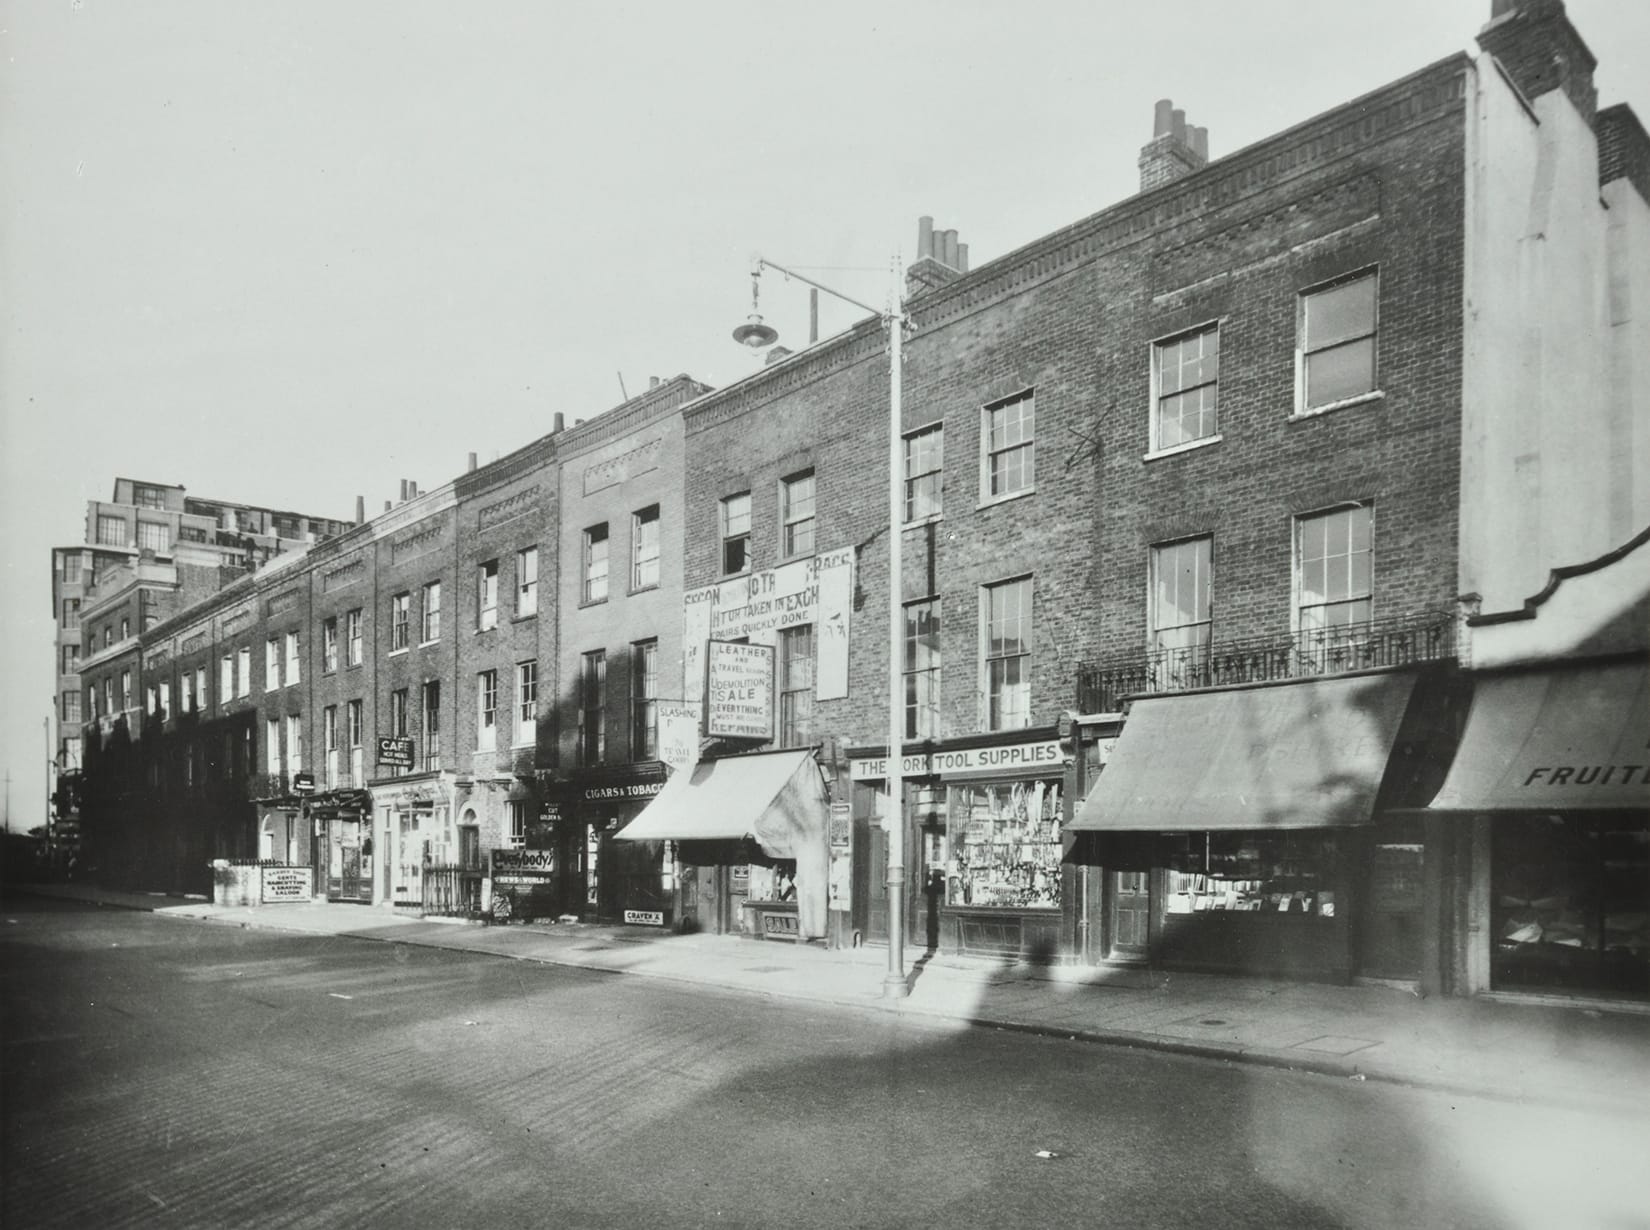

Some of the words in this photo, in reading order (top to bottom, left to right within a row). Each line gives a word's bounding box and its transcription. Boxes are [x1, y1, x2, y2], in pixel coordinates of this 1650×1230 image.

[786, 585, 820, 611] EXCH
[741, 617, 777, 635] QUICKLY
[781, 610, 809, 624] DONE
[719, 645, 766, 657] LEATHER
[719, 664, 744, 673] TRAVEL
[717, 678, 765, 690] DEMOLITION
[717, 688, 756, 702] SALE
[660, 707, 697, 719] SLASHING
[717, 703, 763, 715] EVERYTHING
[859, 761, 887, 775] THE
[934, 752, 974, 769] TOOL
[978, 744, 1057, 766] SUPPLIES
[584, 788, 618, 800] CIGARS
[626, 783, 663, 796] TOBACC
